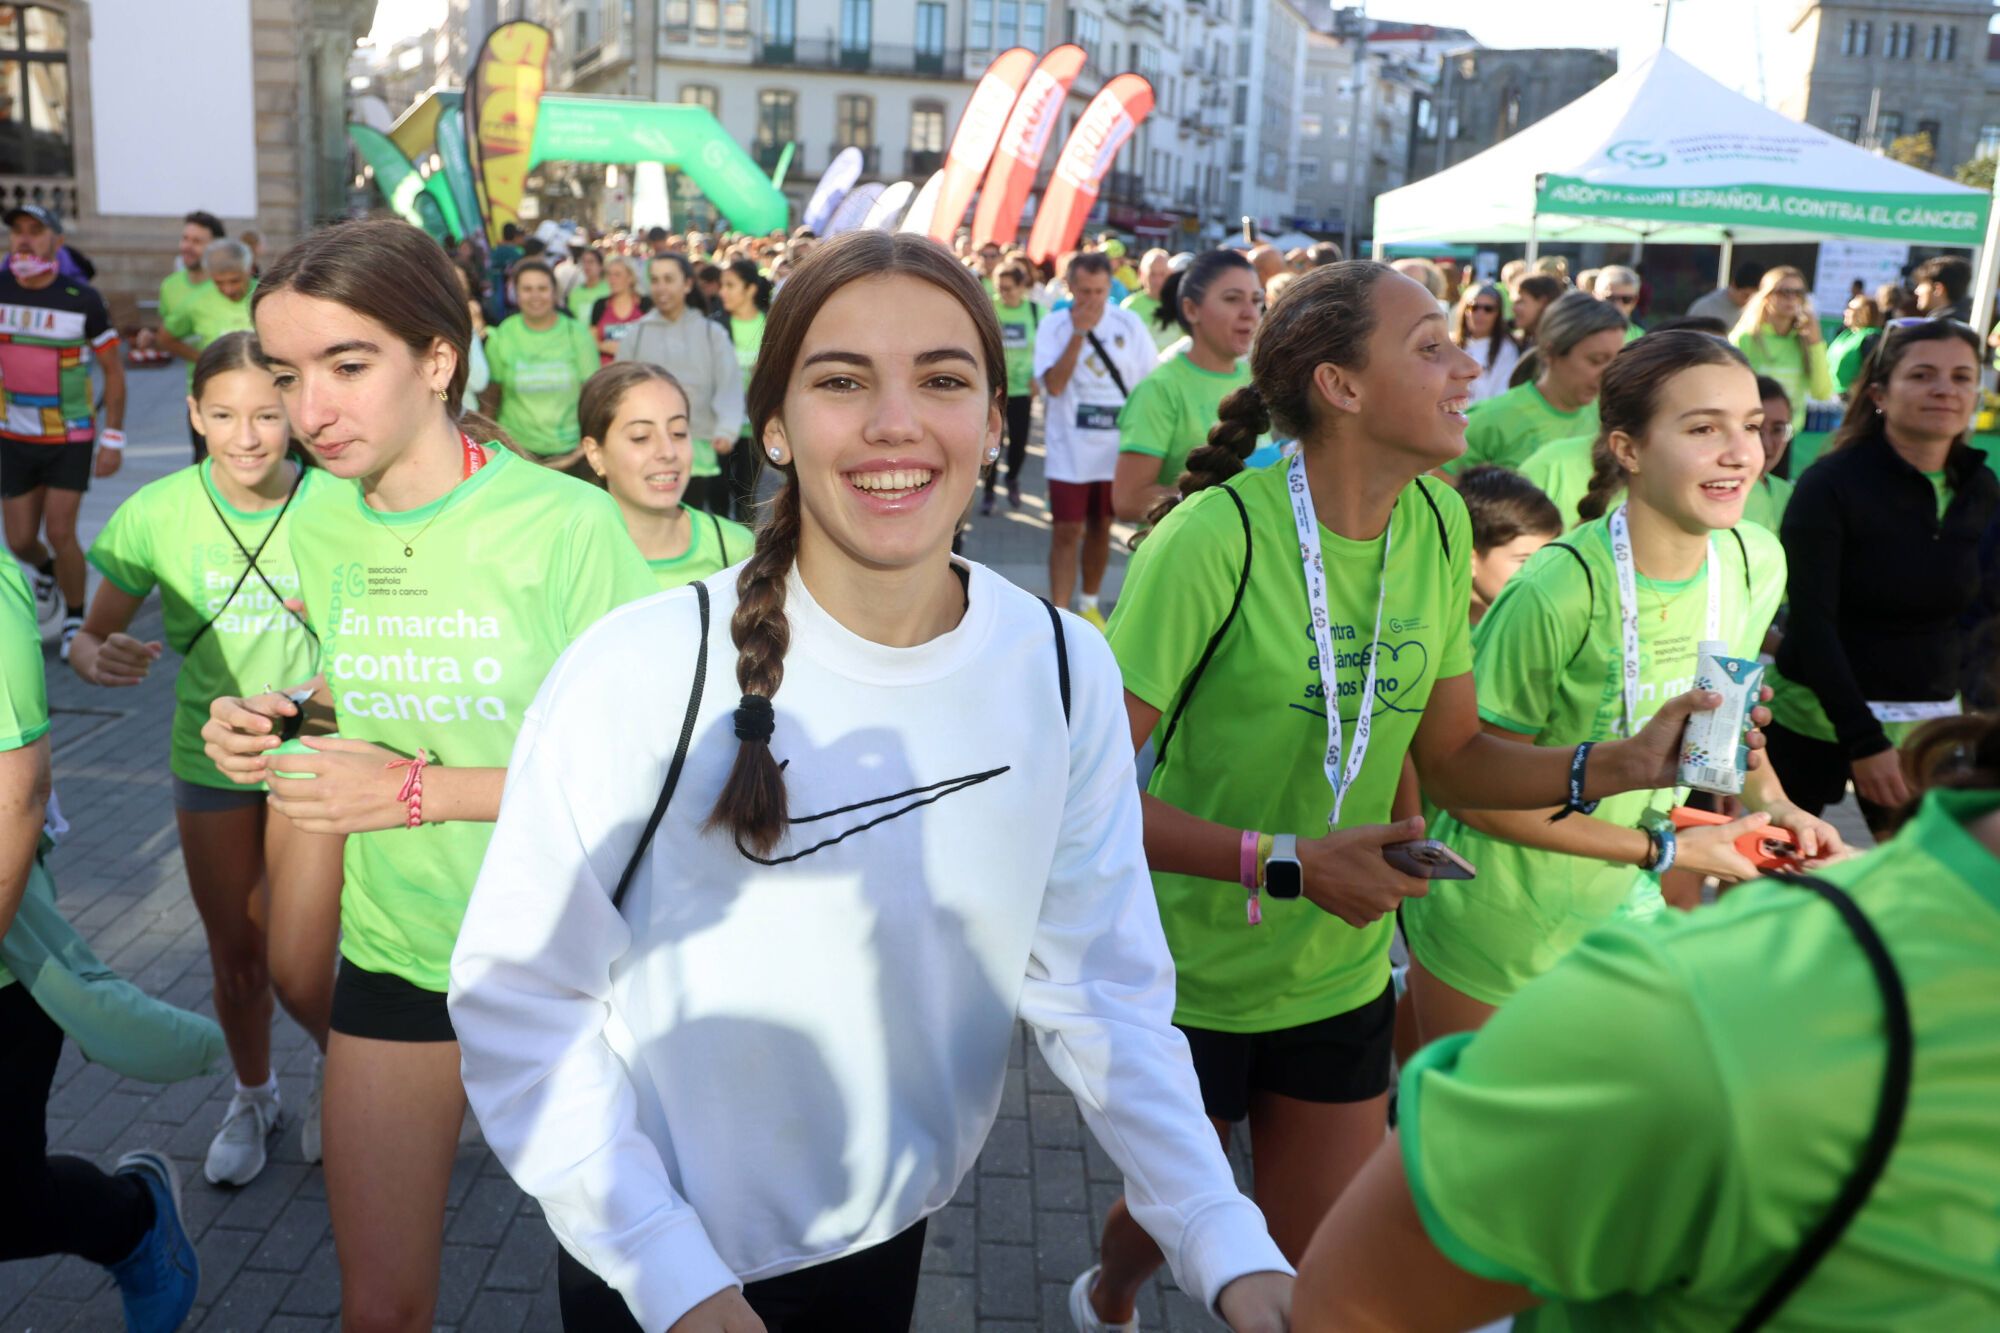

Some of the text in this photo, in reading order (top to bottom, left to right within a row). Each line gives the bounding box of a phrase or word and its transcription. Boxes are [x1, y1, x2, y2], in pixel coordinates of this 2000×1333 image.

[1677, 187, 1781, 213] ESPAÑOLA
[1783, 196, 1866, 222] CONTRA
[1867, 204, 1893, 226] EL
[1895, 205, 1978, 231] CÁNCER
[205, 570, 235, 590] En
[338, 608, 500, 639] En marcha
[1306, 622, 1356, 642] Cntra
[334, 647, 502, 685] contra o
[343, 690, 507, 724] cancro
